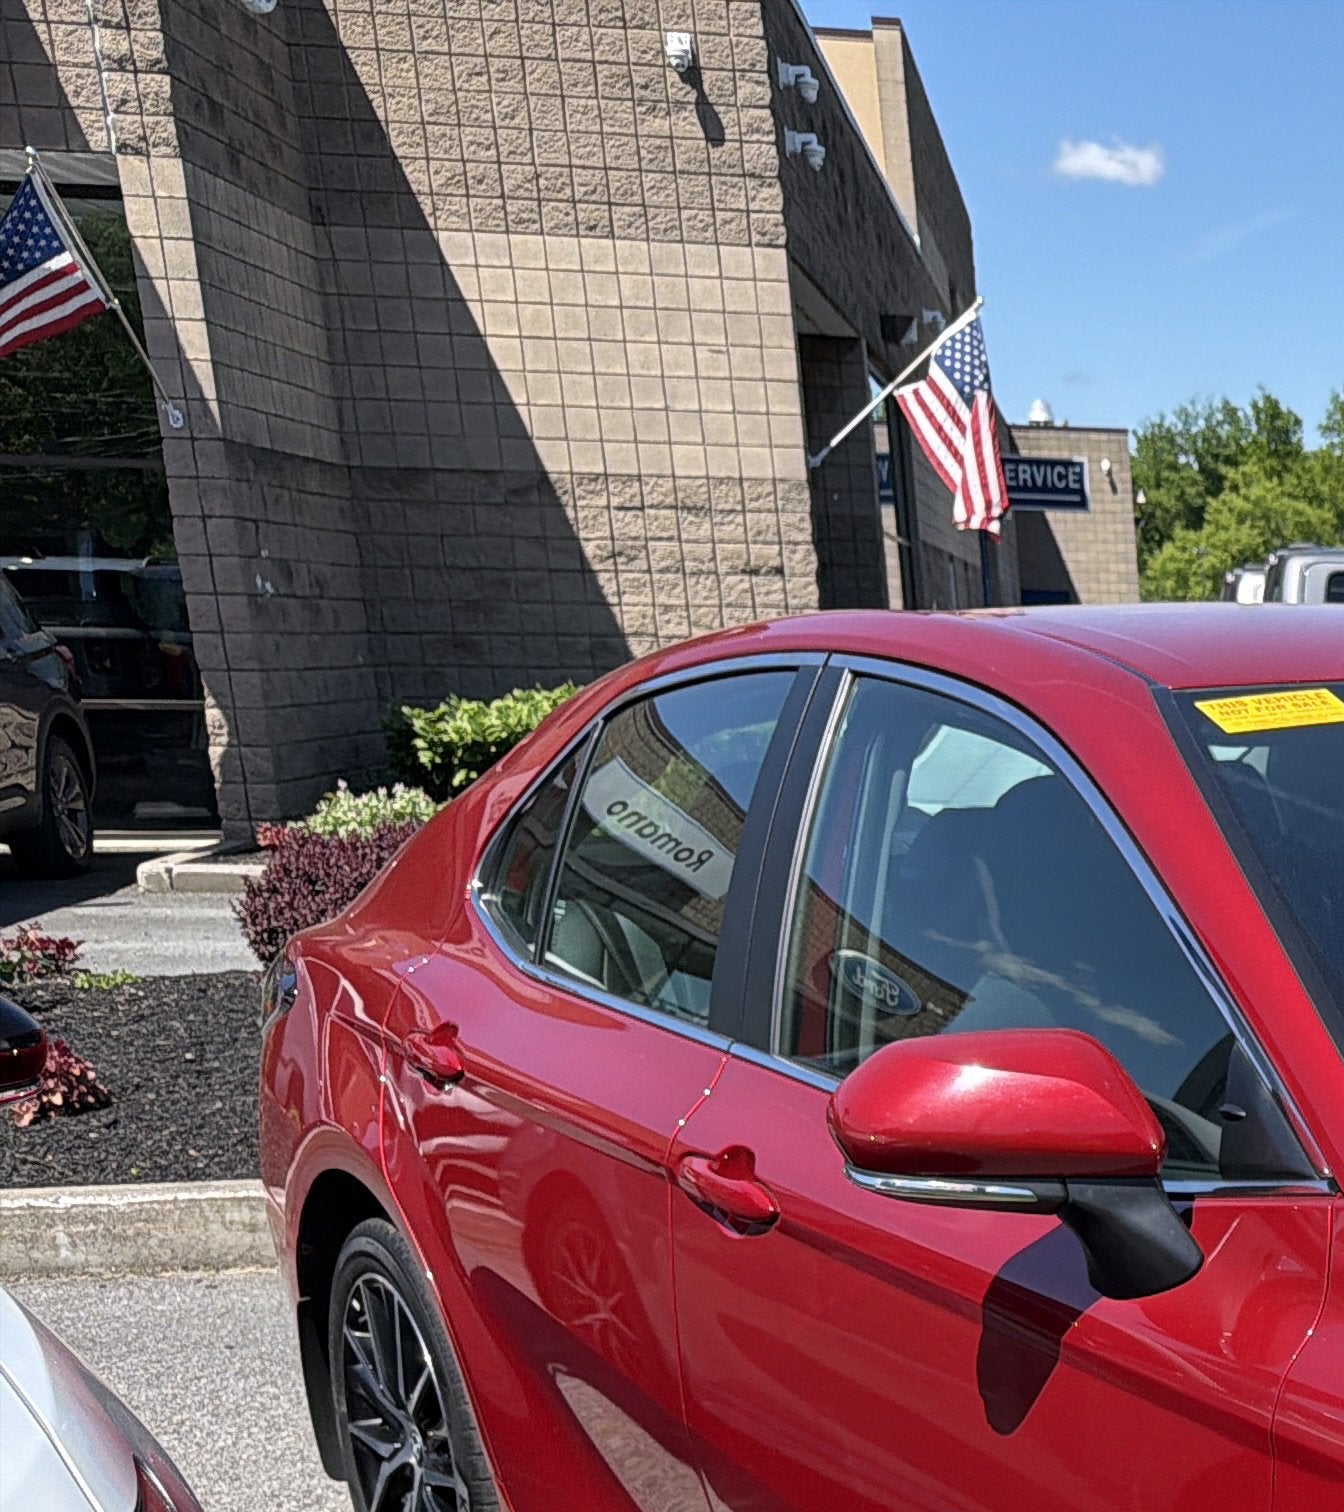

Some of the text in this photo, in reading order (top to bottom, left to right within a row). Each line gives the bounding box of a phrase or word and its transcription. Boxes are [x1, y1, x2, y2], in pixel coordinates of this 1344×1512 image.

[1004, 462, 1081, 490] ERVICE
[1204, 692, 1327, 711] THIS VEHICLE
[1218, 699, 1331, 717] NOT FOR SALE
